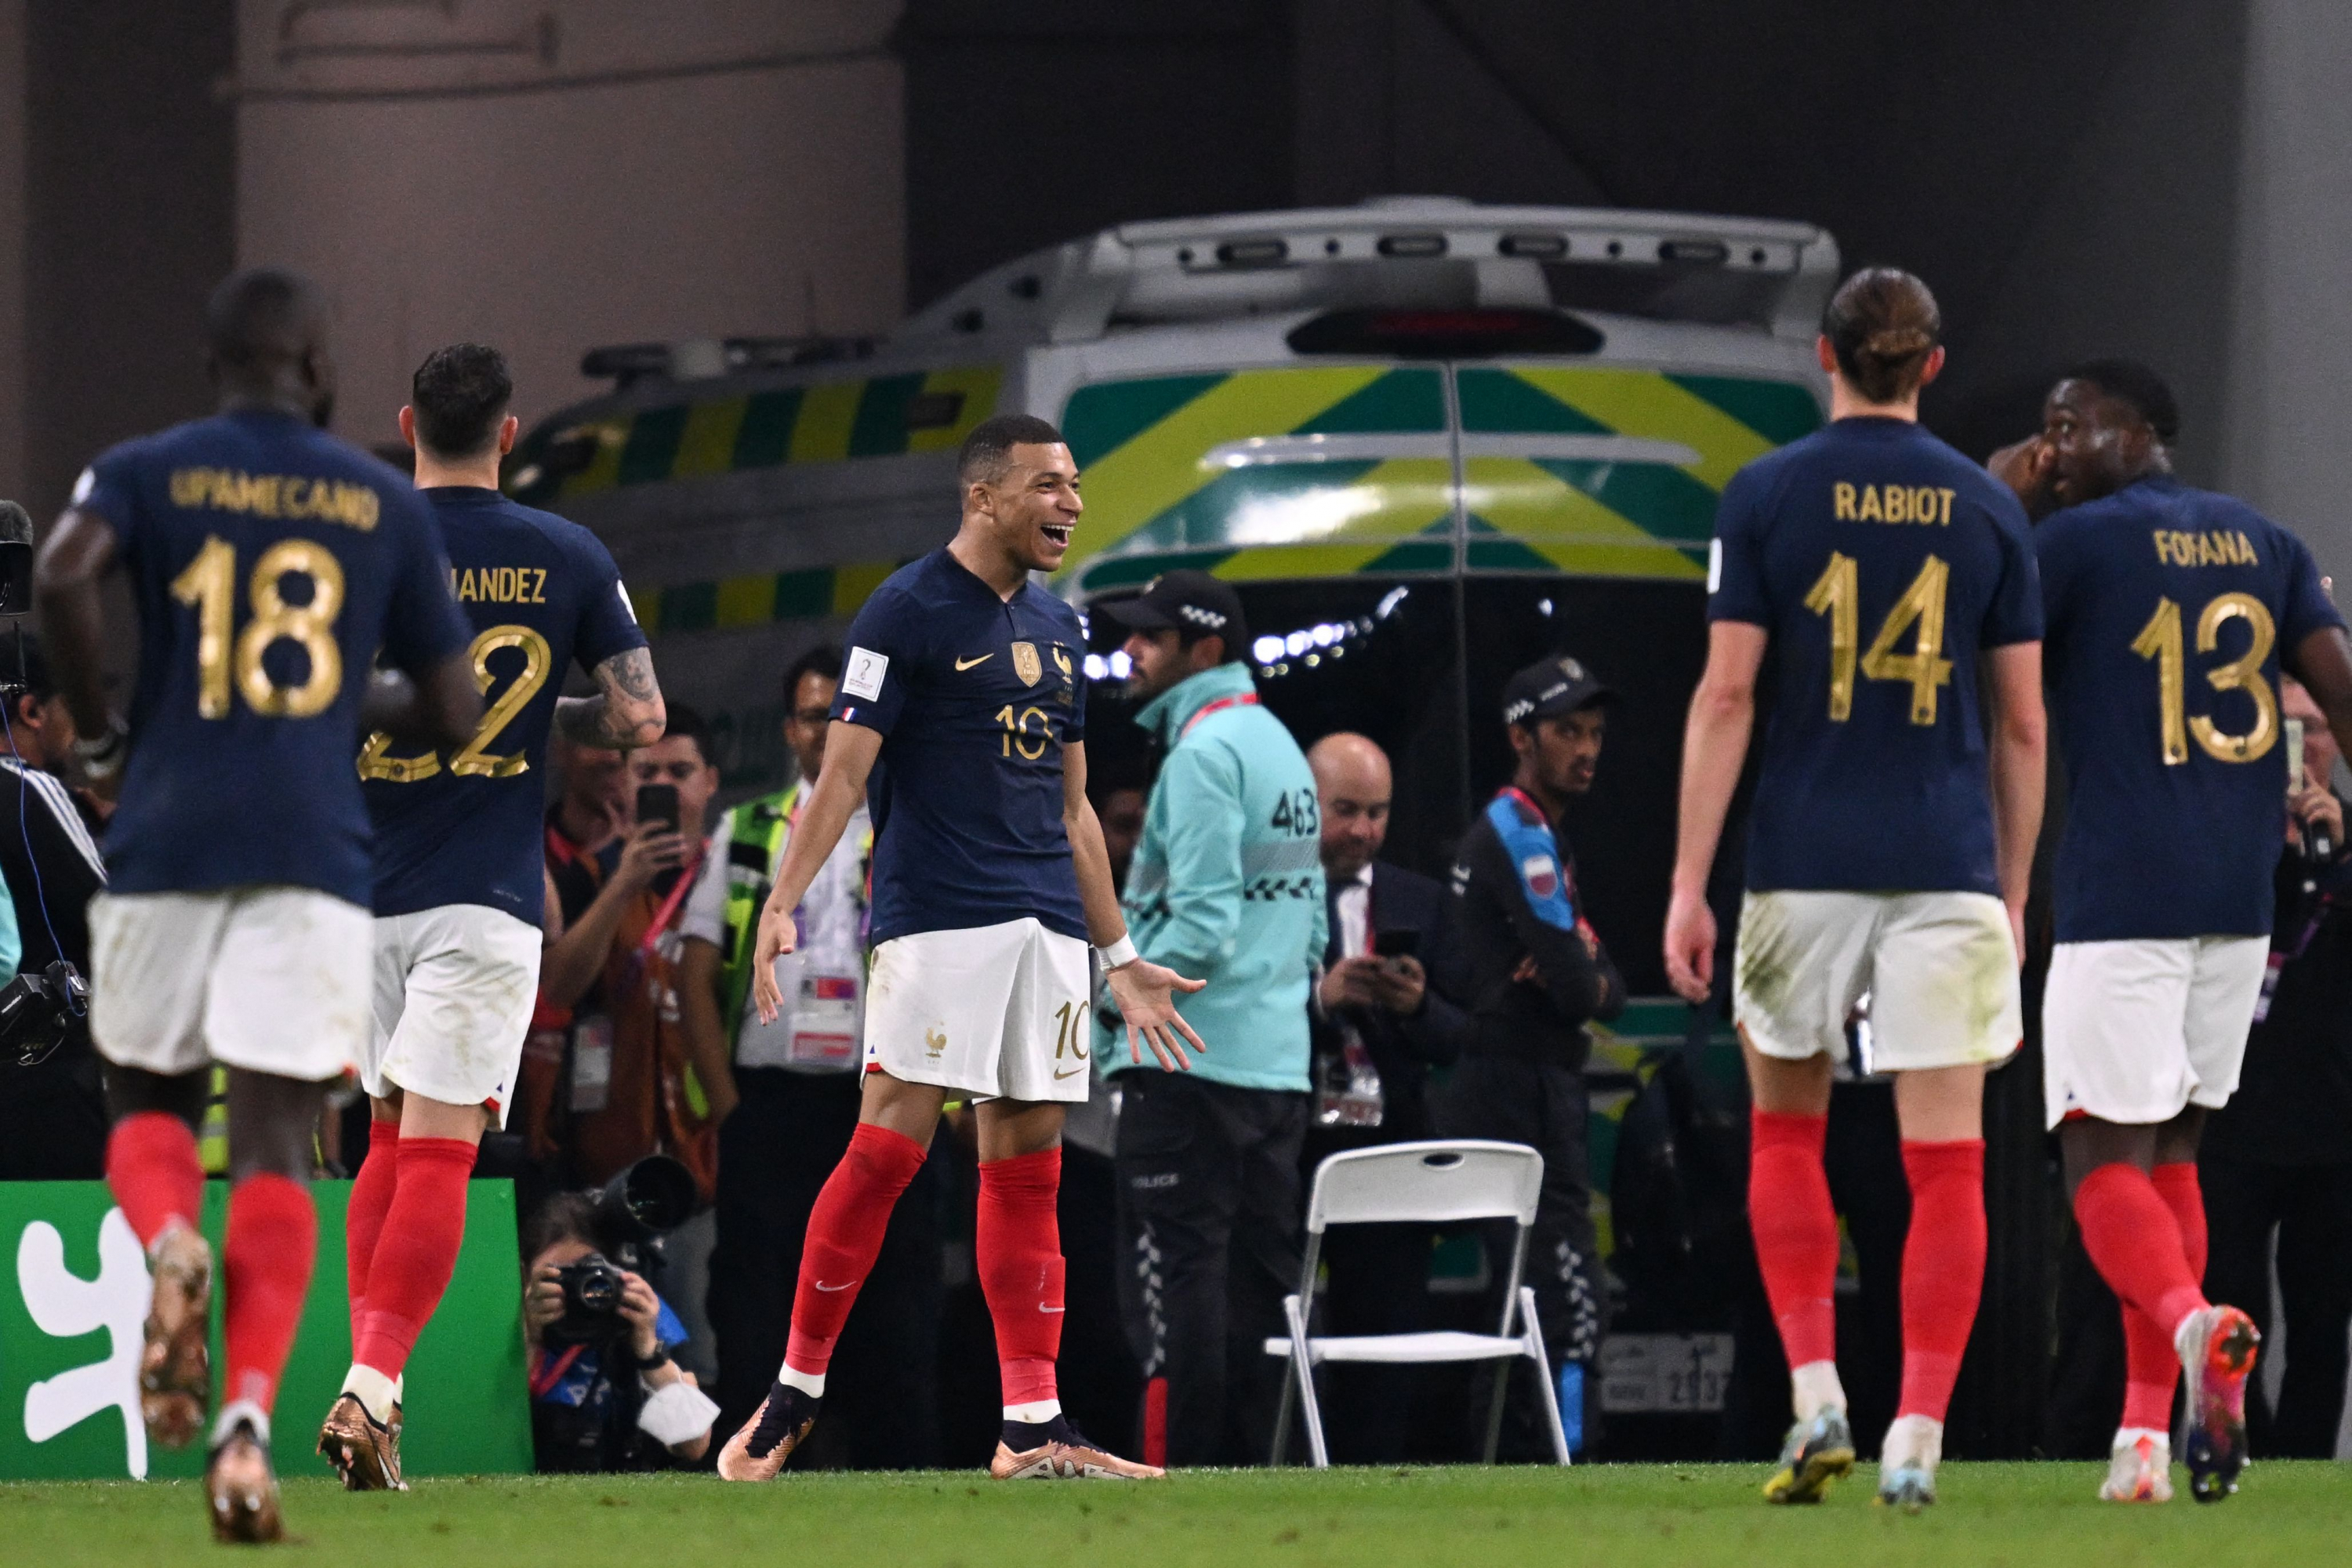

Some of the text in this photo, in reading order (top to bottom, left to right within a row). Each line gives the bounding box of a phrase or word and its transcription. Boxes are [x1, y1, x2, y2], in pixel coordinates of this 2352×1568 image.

[171, 468, 379, 531] UPAMECANO
[1834, 482, 1955, 526] RABIOT
[2154, 530, 2259, 567] FOFANA
[449, 567, 547, 604] ANDEZ
[170, 535, 345, 719] 18
[1804, 551, 1954, 726] 14
[2131, 592, 2280, 765] 13
[995, 704, 1053, 760] 10
[1272, 789, 1317, 837] 463
[1054, 1000, 1090, 1060] 10
